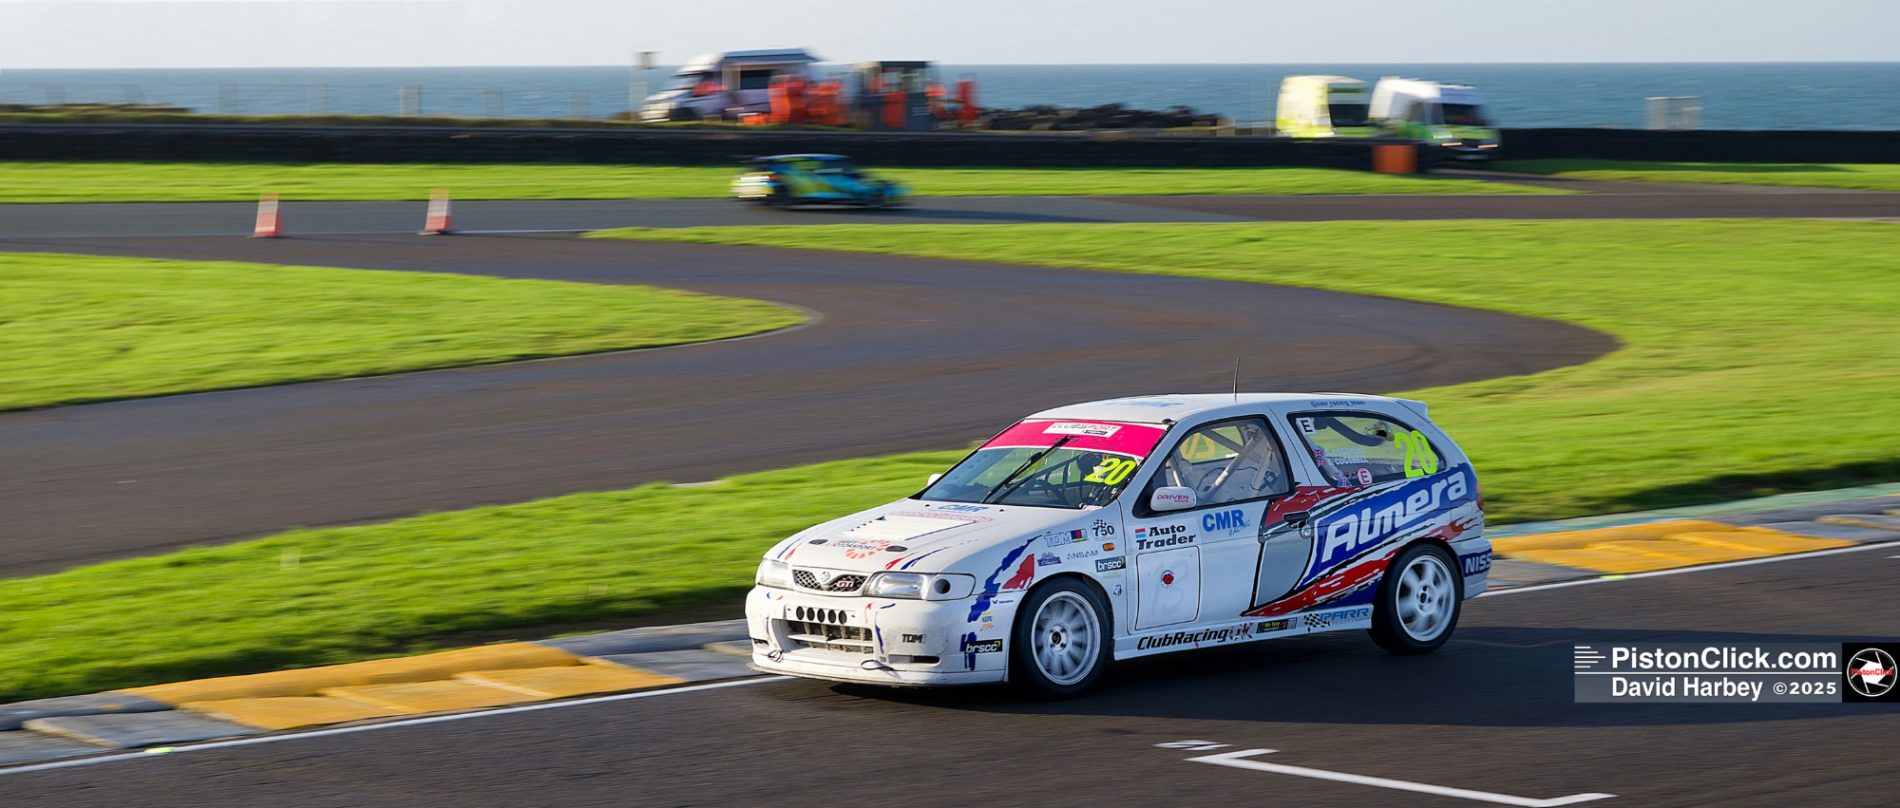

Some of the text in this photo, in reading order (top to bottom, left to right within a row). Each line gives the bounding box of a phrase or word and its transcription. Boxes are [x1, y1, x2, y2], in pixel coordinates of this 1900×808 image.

[1300, 420, 1313, 433] E
[1394, 430, 1438, 478] 20
[1083, 457, 1137, 485] 20
[1360, 470, 1370, 483] E
[1202, 509, 1246, 532] CMR
[1321, 471, 1468, 563] Almera
[1092, 525, 1115, 537] 750
[1148, 524, 1186, 537] Auto
[1044, 531, 1073, 547] TDM
[1136, 534, 1196, 550] Trader
[1066, 550, 1098, 560] ANSAM
[1097, 560, 1122, 571] brscc
[902, 633, 923, 644] TDM
[966, 643, 998, 653] brscc
